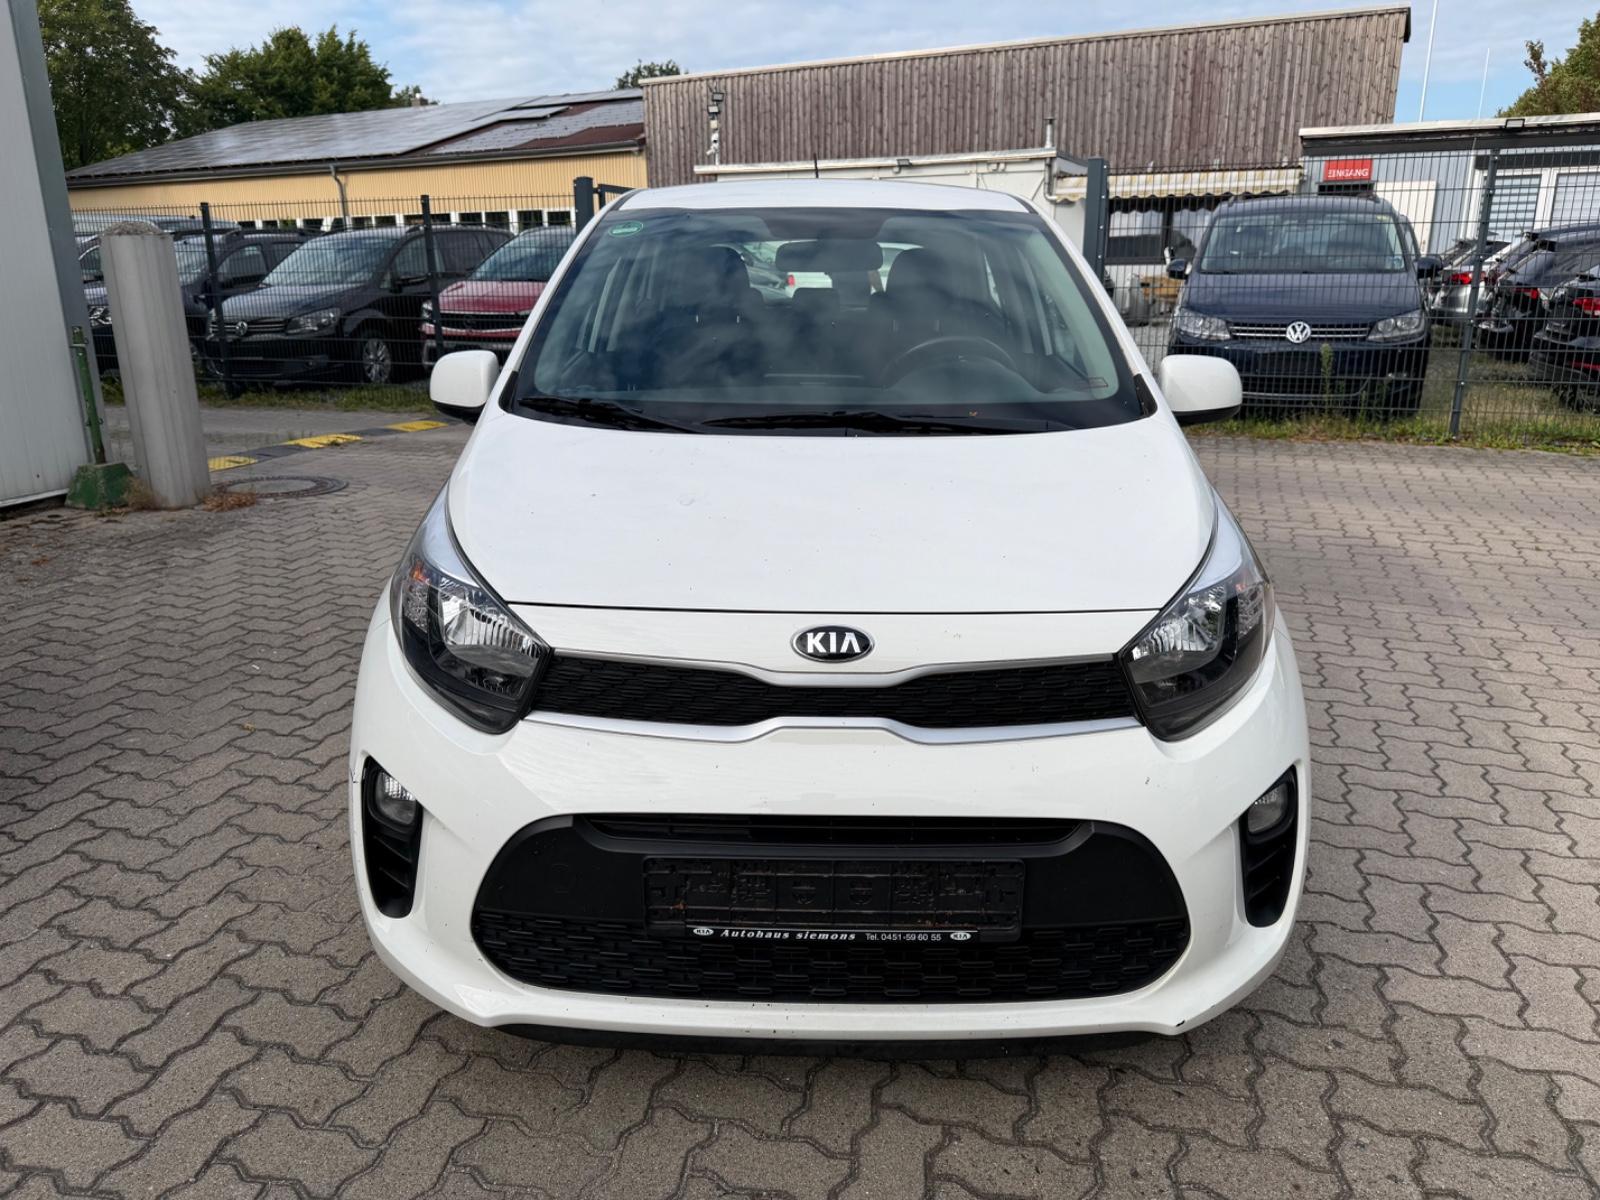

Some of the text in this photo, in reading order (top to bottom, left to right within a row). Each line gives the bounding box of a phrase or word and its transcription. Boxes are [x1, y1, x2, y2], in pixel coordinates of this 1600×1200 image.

[806, 631, 862, 654] KIA
[720, 929, 790, 939] Autohaus
[796, 931, 856, 940] siemons
[865, 933, 879, 941] Tel.
